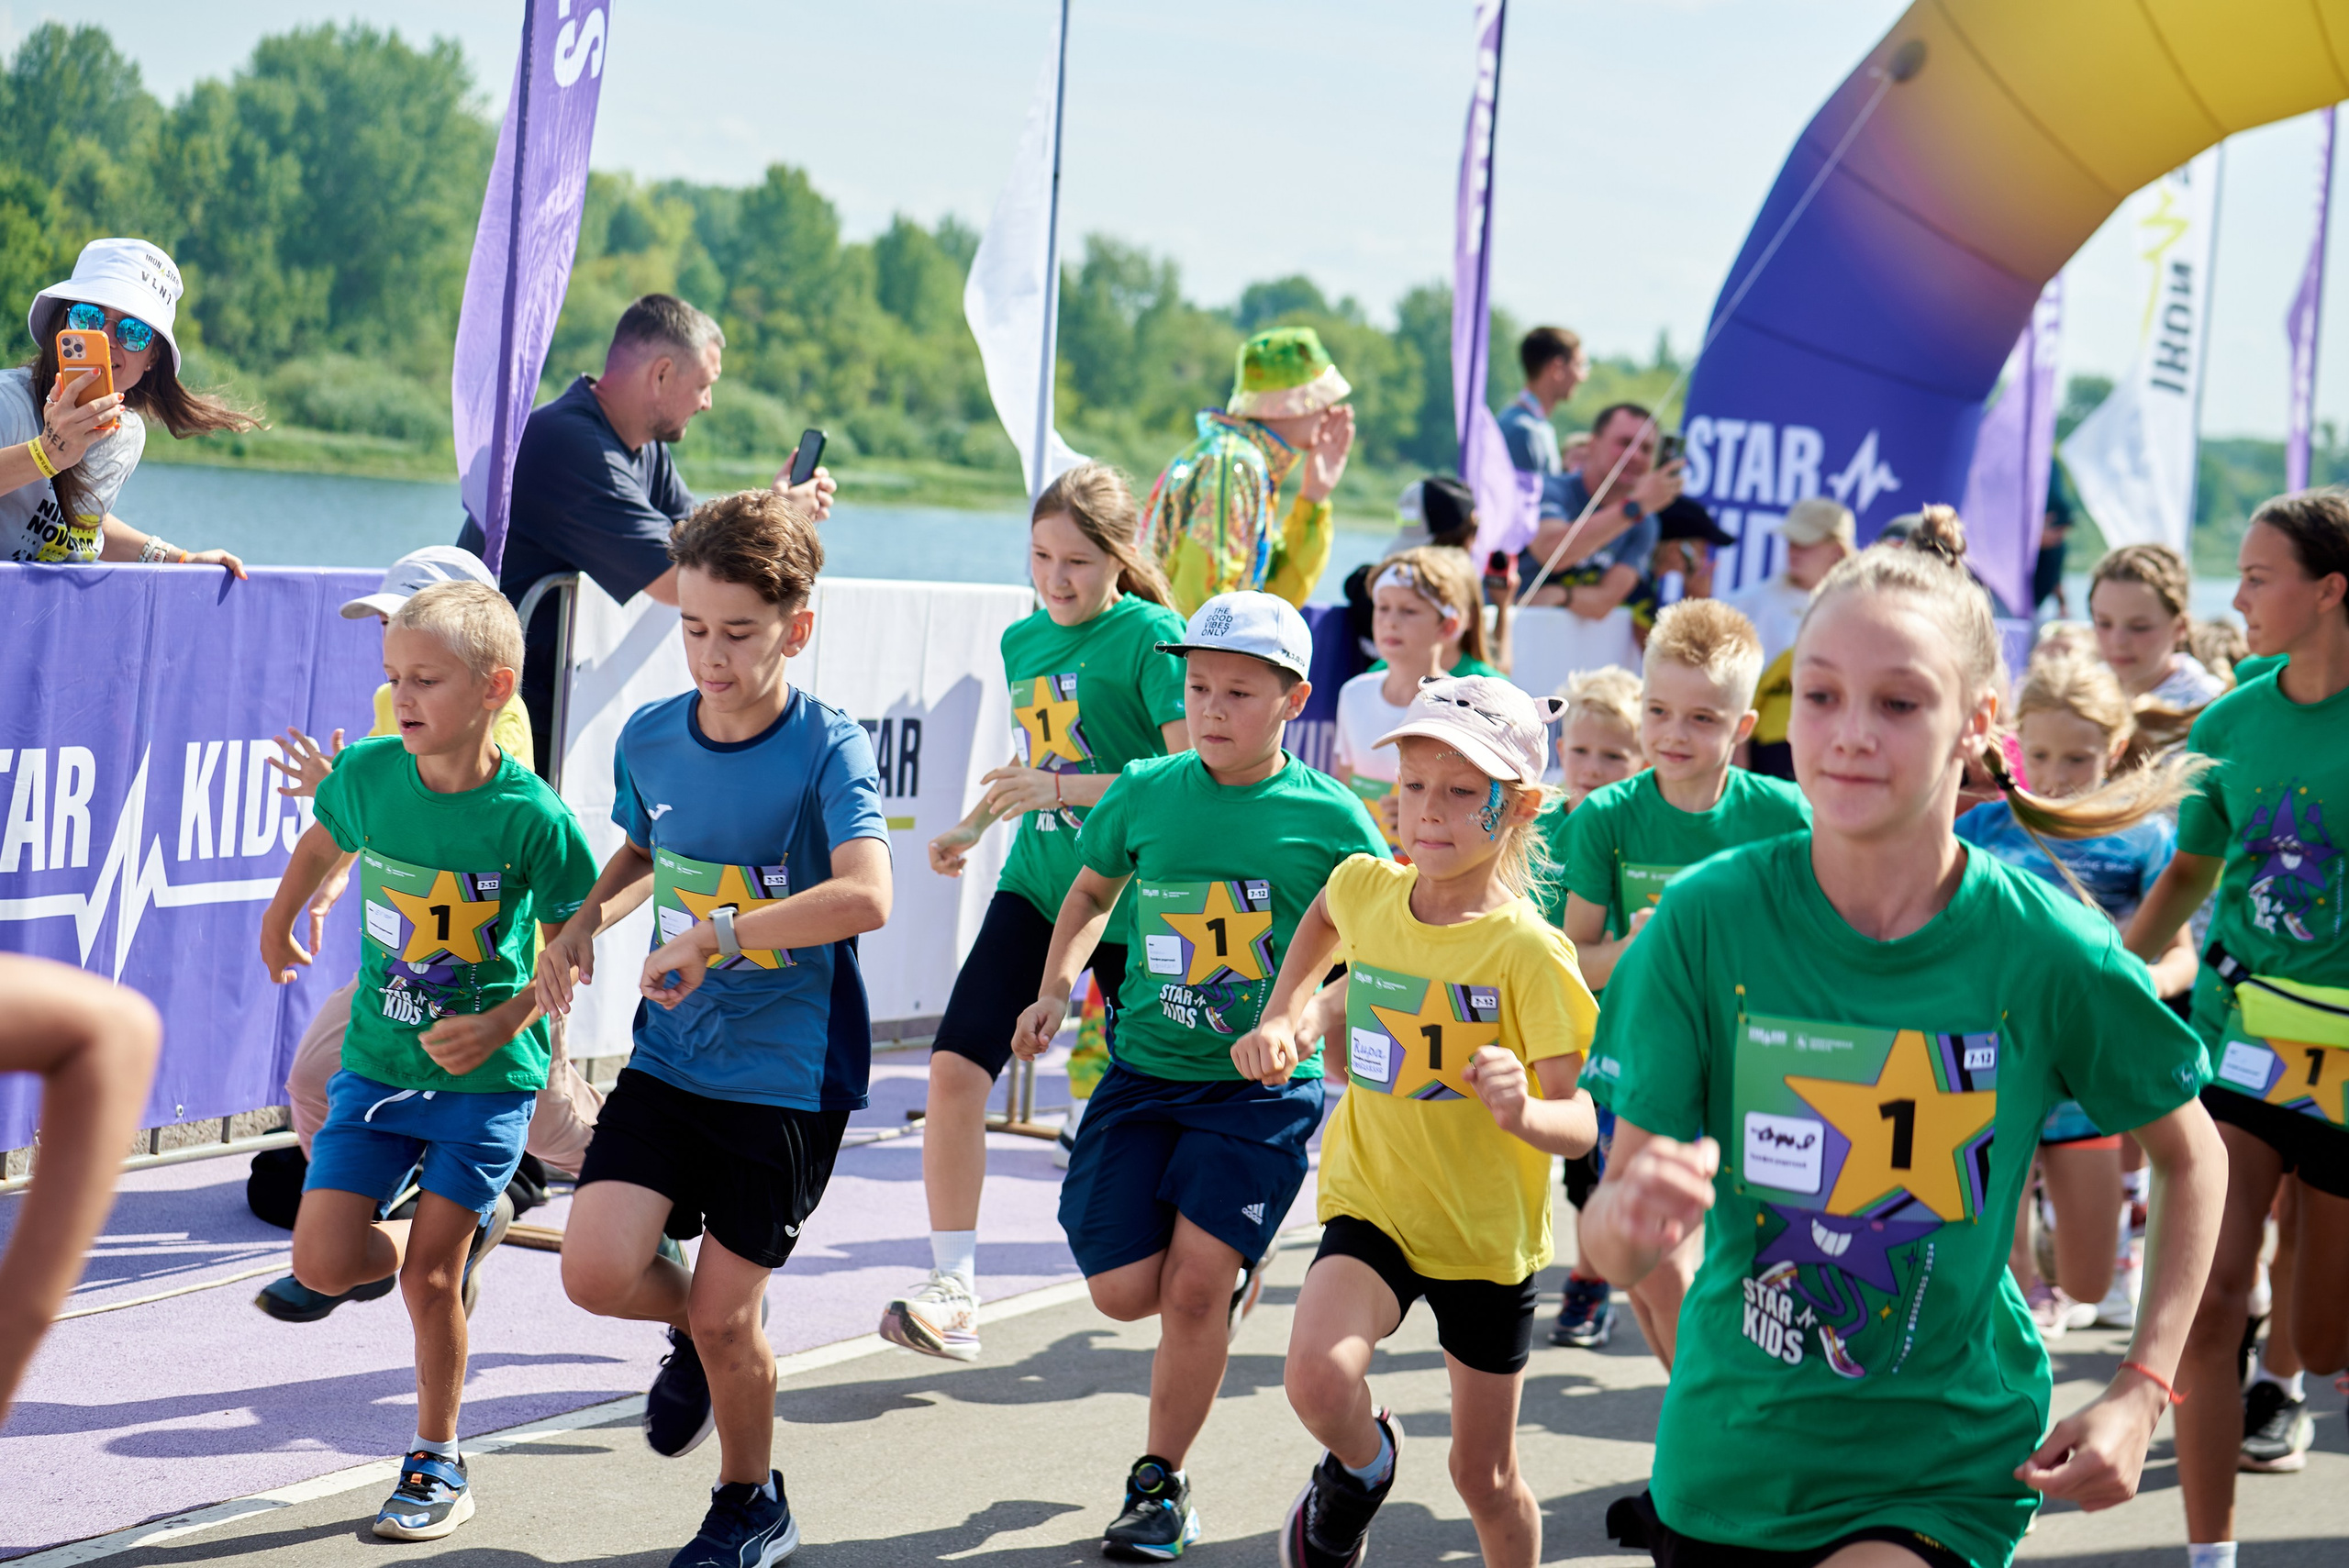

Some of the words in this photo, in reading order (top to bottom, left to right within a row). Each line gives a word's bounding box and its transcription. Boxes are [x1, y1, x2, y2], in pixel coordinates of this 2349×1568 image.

[145, 253, 162, 269] IRON
[165, 270, 180, 287] STAR
[1681, 415, 1824, 506] STAR
[1201, 628, 1229, 637] ONLY
[1204, 621, 1230, 630] VIBES
[1207, 614, 1233, 623] GOOD
[1035, 708, 1052, 742] 1
[178, 736, 321, 862] KIDS
[1036, 812, 1060, 832] KID
[480, 881, 497, 889] 7-12
[429, 904, 451, 941] 1
[1206, 917, 1228, 957] 1
[382, 992, 424, 1026] KIDS
[1159, 984, 1194, 1006] STAR
[1475, 996, 1494, 1006] 7-12
[1160, 999, 1198, 1029] KIDS
[1419, 1024, 1442, 1071] 1
[1967, 1050, 1993, 1066] 7-12
[2304, 1048, 2325, 1086] 1
[1878, 1097, 1916, 1172] 1
[1742, 1276, 1794, 1328] STAR
[1742, 1300, 1804, 1366] KIDS
